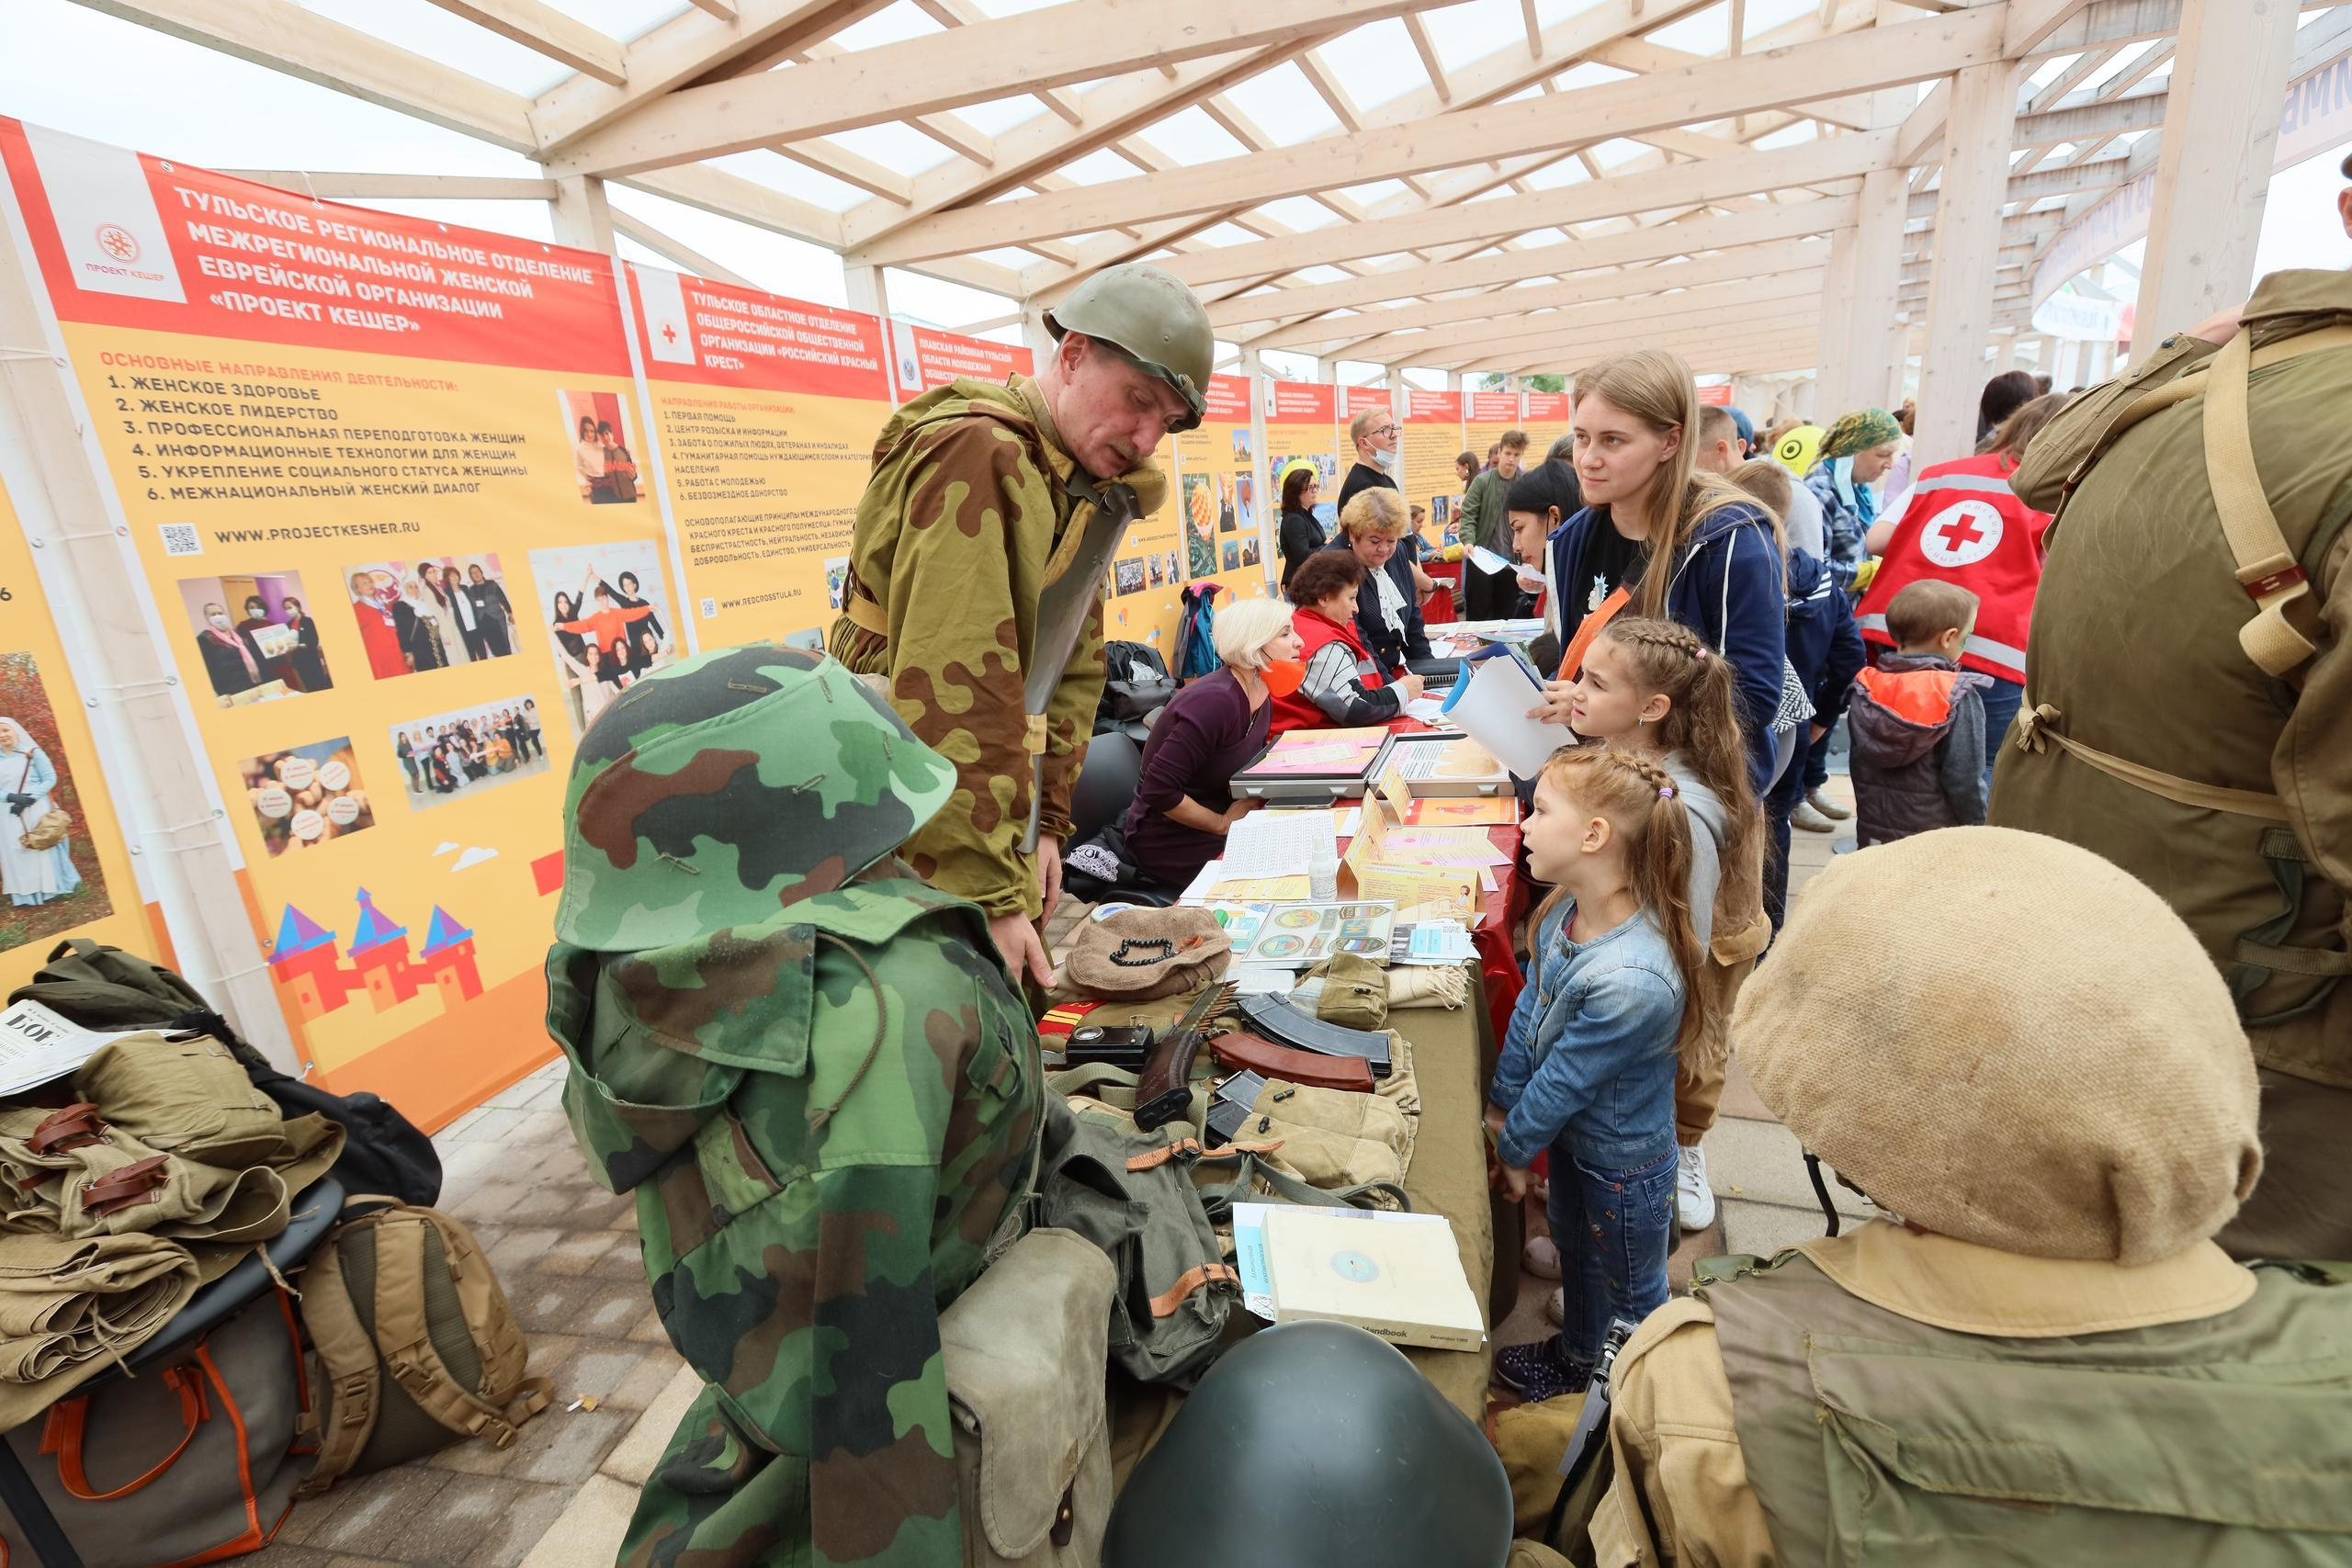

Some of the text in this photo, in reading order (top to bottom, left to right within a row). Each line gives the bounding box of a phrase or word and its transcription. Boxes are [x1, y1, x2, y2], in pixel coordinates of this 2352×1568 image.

[173, 186, 594, 285] ТУЛЬСКОЕ РЕГИОНАЛЬНОЕ ОТДЕЛЕНИЕ
[187, 220, 534, 299] МЕЖРЕГИОНАЛЬНОЙ ЖЕНСКОЙ
[85, 263, 128, 276] ПРОЕКТ
[198, 254, 503, 319] ЕВРЕЙСКОЙ ОРГАНИЗАЦИИ
[209, 290, 420, 333] «ПРОЕКТ КЕШЕР»
[691, 291, 857, 334] ТУЛЬСКОЕ ОБЛАСТНОЕ ОТДЕЛЕНИЕ
[695, 312, 865, 353] ОБЩЕРОССИЙСКОЙ ОБЩЕСТВЕННОЙ
[700, 334, 878, 371] ОРГАНИЗАЦИИ «РОССИЙСКИЙ КРАСНЫЙ
[919, 338, 1012, 363] ПЛАВСКАЯ РАЙОННАЯ ТУЛЬСКОЙ
[922, 354, 952, 366] ОБЛАСТИ
[100, 352, 459, 391] ОСНОВНЫЕ НАПРАВЛЕНИЯ ДЕЯТЕЛЬНОСТИ:
[704, 354, 744, 371] КРЕСТ»
[108, 376, 321, 400] 1. ЖЕНСКОЕ ЗДОРОВЬЕ
[116, 398, 338, 420] 2. ЖЕНСКОЕ ЛИДЕРСТВО
[662, 397, 719, 410] НАПРАВЛЕНИЯ
[718, 401, 747, 412] РАБОТЫ
[663, 412, 736, 423] 1. ПЕРВАЯ ПОМОЩЬ
[123, 421, 526, 445] 3. ПРОФЕССИОНАЛЬНАЯ ПЕРЕПОДГОТОВКА ЖЕНЩИН
[667, 425, 787, 437] 2. ЦЕНТР РОЗЫСКА И ИНФОРМАЦИИ
[132, 444, 516, 460] 4. ИНФОРМАЦИОННЫЕ ТЕХНОЛОГИИ ДЛЯ ЖЕНЩИН
[669, 438, 676, 447] 3.
[677, 439, 707, 447] ЗАБОТА
[713, 440, 750, 448] ПОЖИЛЫХ
[750, 441, 776, 450] ЛЮДЯХ,
[776, 441, 812, 450] ВЕТЕРАНАХ
[817, 442, 849, 451] ИНВАЛИДАХ
[673, 451, 680, 459] 4.
[680, 451, 739, 460] ГУМАНИТАРНАЯ
[739, 452, 769, 461] ПОМОЩЬ
[769, 453, 821, 462] НУЖДАЮЩИМСЯ
[138, 466, 527, 479] 5. УКРЕПЛЕНИЕ СОЦИАЛЬНОГО СТАТУСА ЖЕНЩИНЫ
[674, 466, 720, 474] НАСЕЛЕНИЯ
[147, 481, 481, 500] 6. МЕЖНАЦИОНАЛЬНЫЙ ЖЕНСКИЙ ДИАЛОГ
[685, 478, 714, 487] РАБОТА
[715, 479, 720, 487] С
[720, 478, 765, 487] МОЛОДЕЖЬЮ
[679, 489, 787, 501] 6. БЕЗВОЗМЕЗДНОЕ ДОНОРСТВО
[684, 514, 763, 527] ОСНОВОПОЛАГАЮЩИЕ
[764, 511, 800, 522] ПРИНЦИПЫ
[800, 508, 854, 518] МЕЖДУНАРОДНОГО
[214, 522, 421, 543] WWW.PROJECTKESHER.RU
[690, 530, 726, 540] КРАСНОГО
[727, 527, 753, 536] КРЕСТА
[753, 526, 759, 535] И
[759, 525, 791, 534] КРАСНОГО
[791, 521, 832, 531] ПОЛУМЕСЯЦА:
[690, 539, 767, 553] БЕСПРИСТРАСТНОСТЬ,
[768, 534, 820, 545] НЕЙТРАЛЬНОСТЬ,
[694, 553, 762, 567] ДОБРОВОЛЬНОСТЬ,
[763, 548, 797, 558] ЕДИНСТВО,
[721, 589, 802, 609] WWW.REDCROSSTULA.RU
